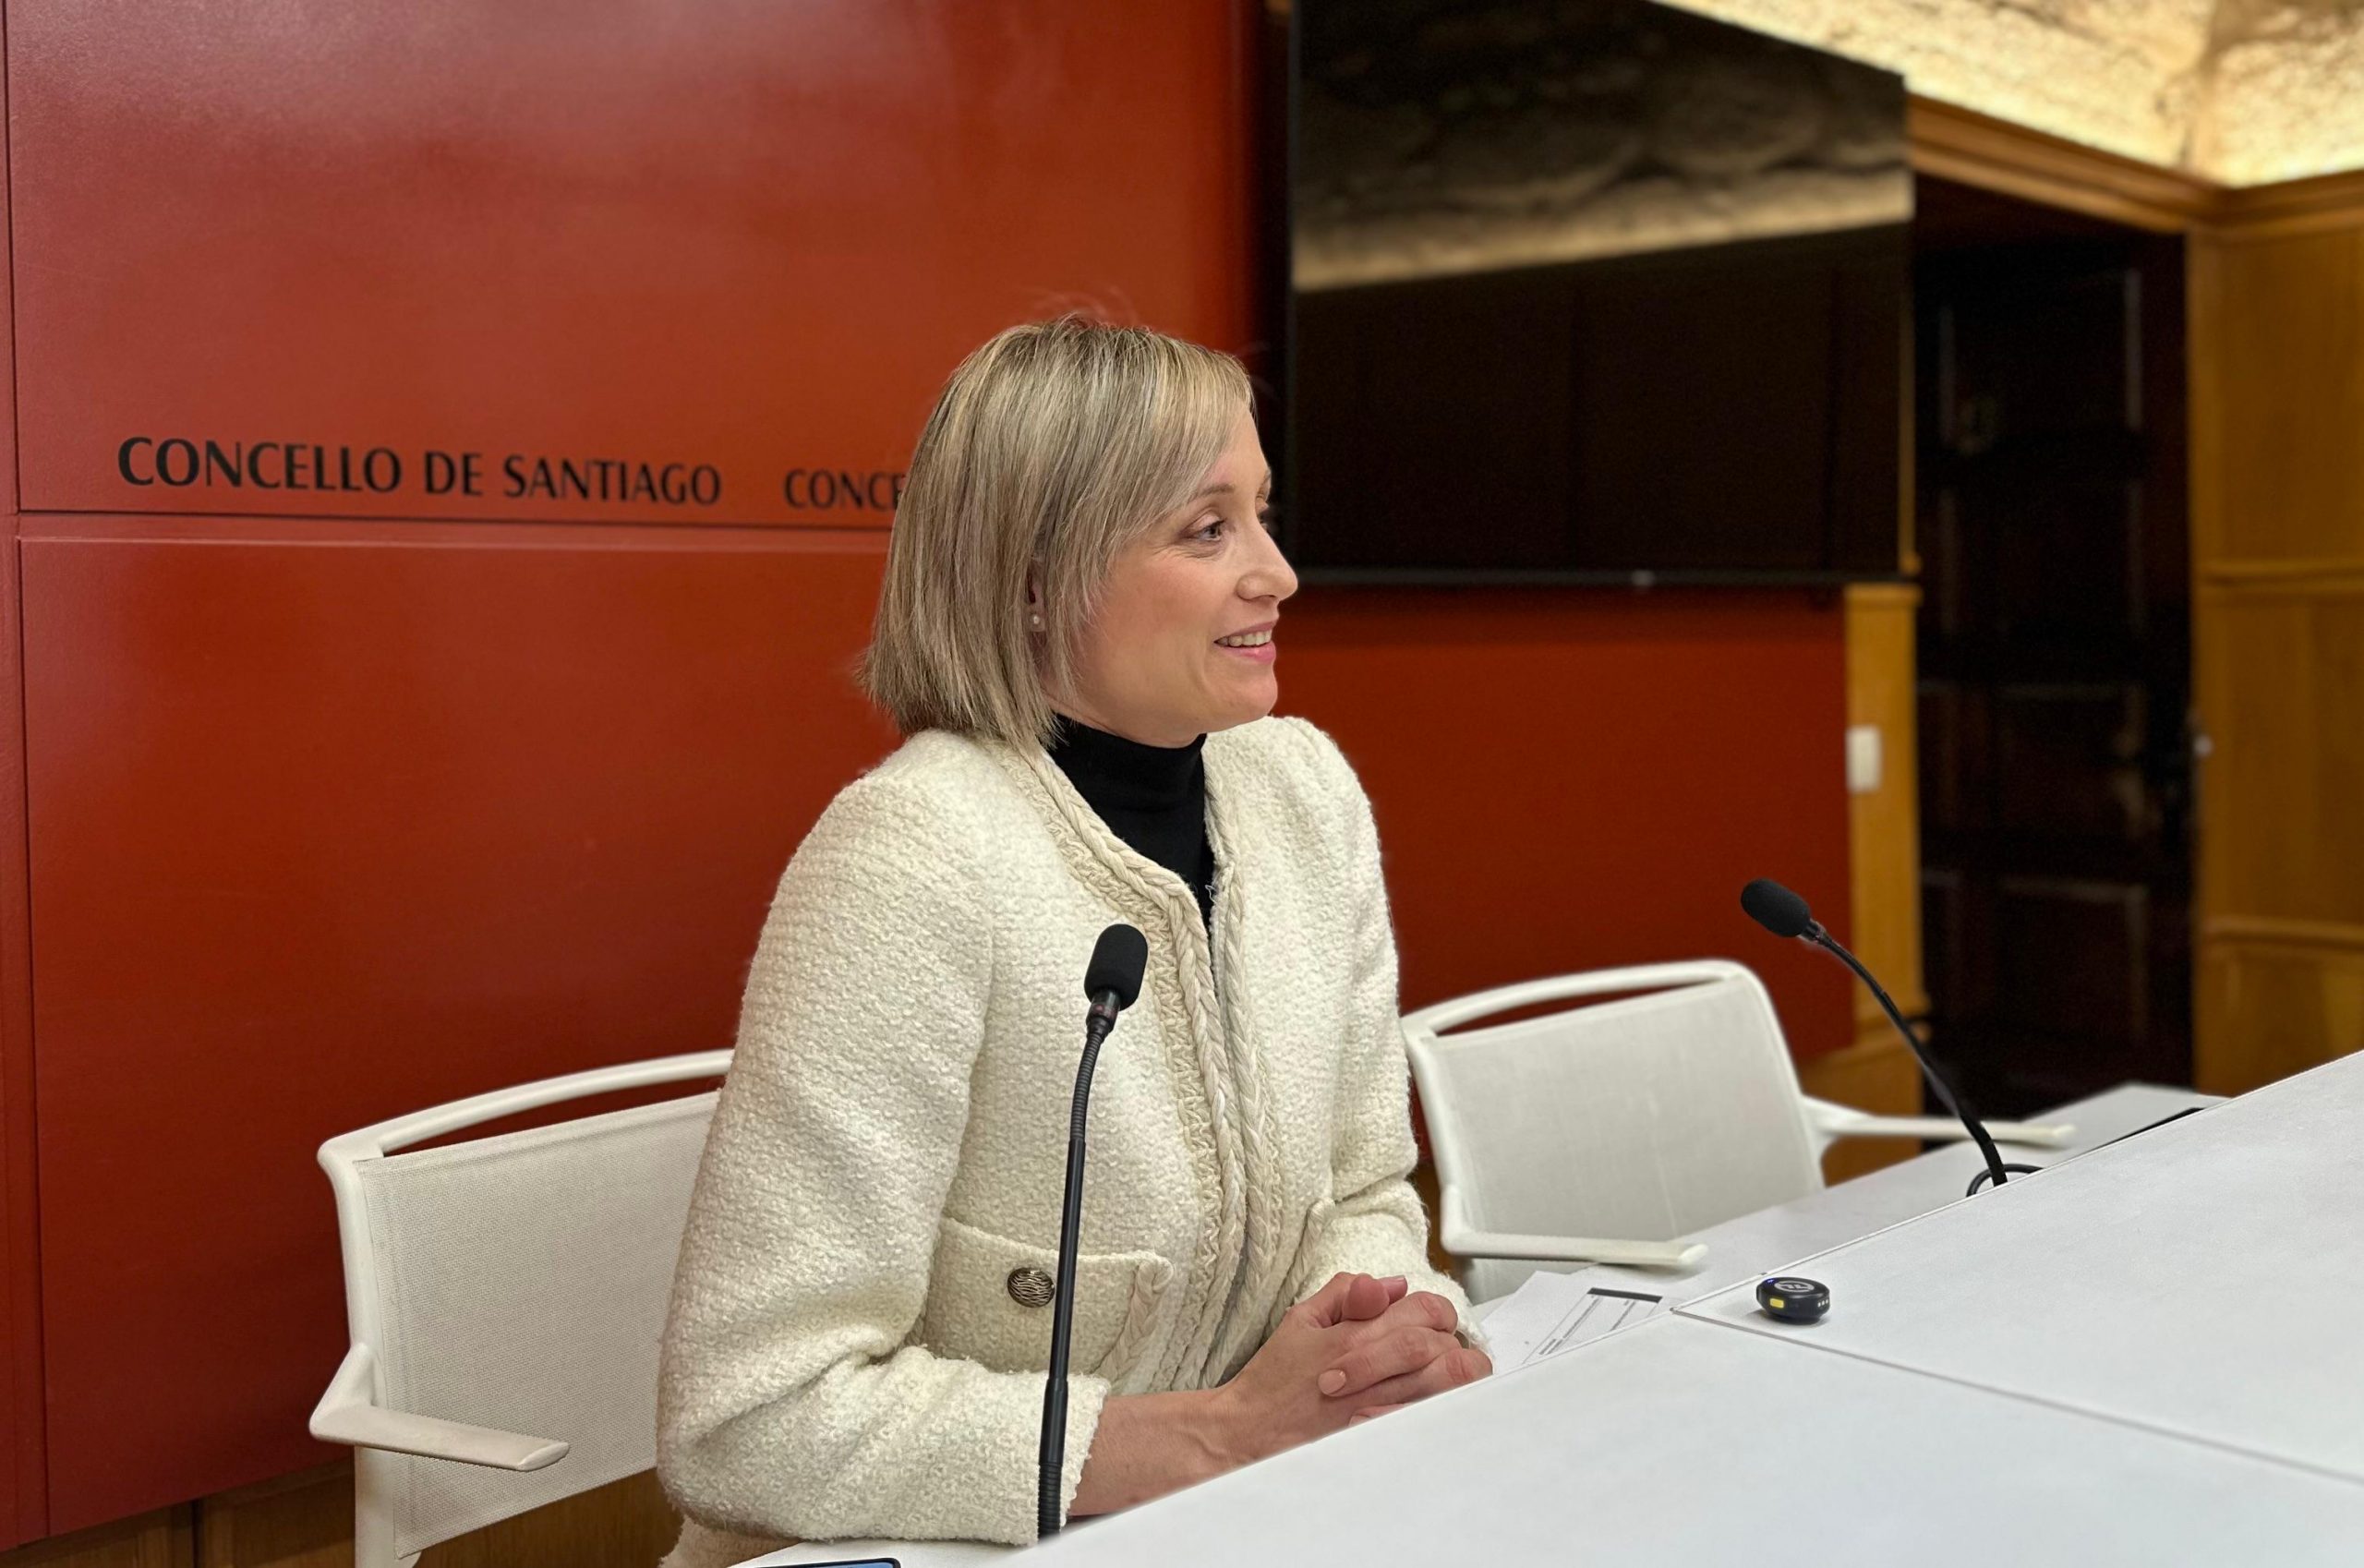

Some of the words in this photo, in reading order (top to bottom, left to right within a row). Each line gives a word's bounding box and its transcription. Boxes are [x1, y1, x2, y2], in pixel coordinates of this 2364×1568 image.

[117, 436, 403, 492] CONCELLO
[424, 451, 483, 496] DE
[502, 455, 722, 505] SANTIAGO
